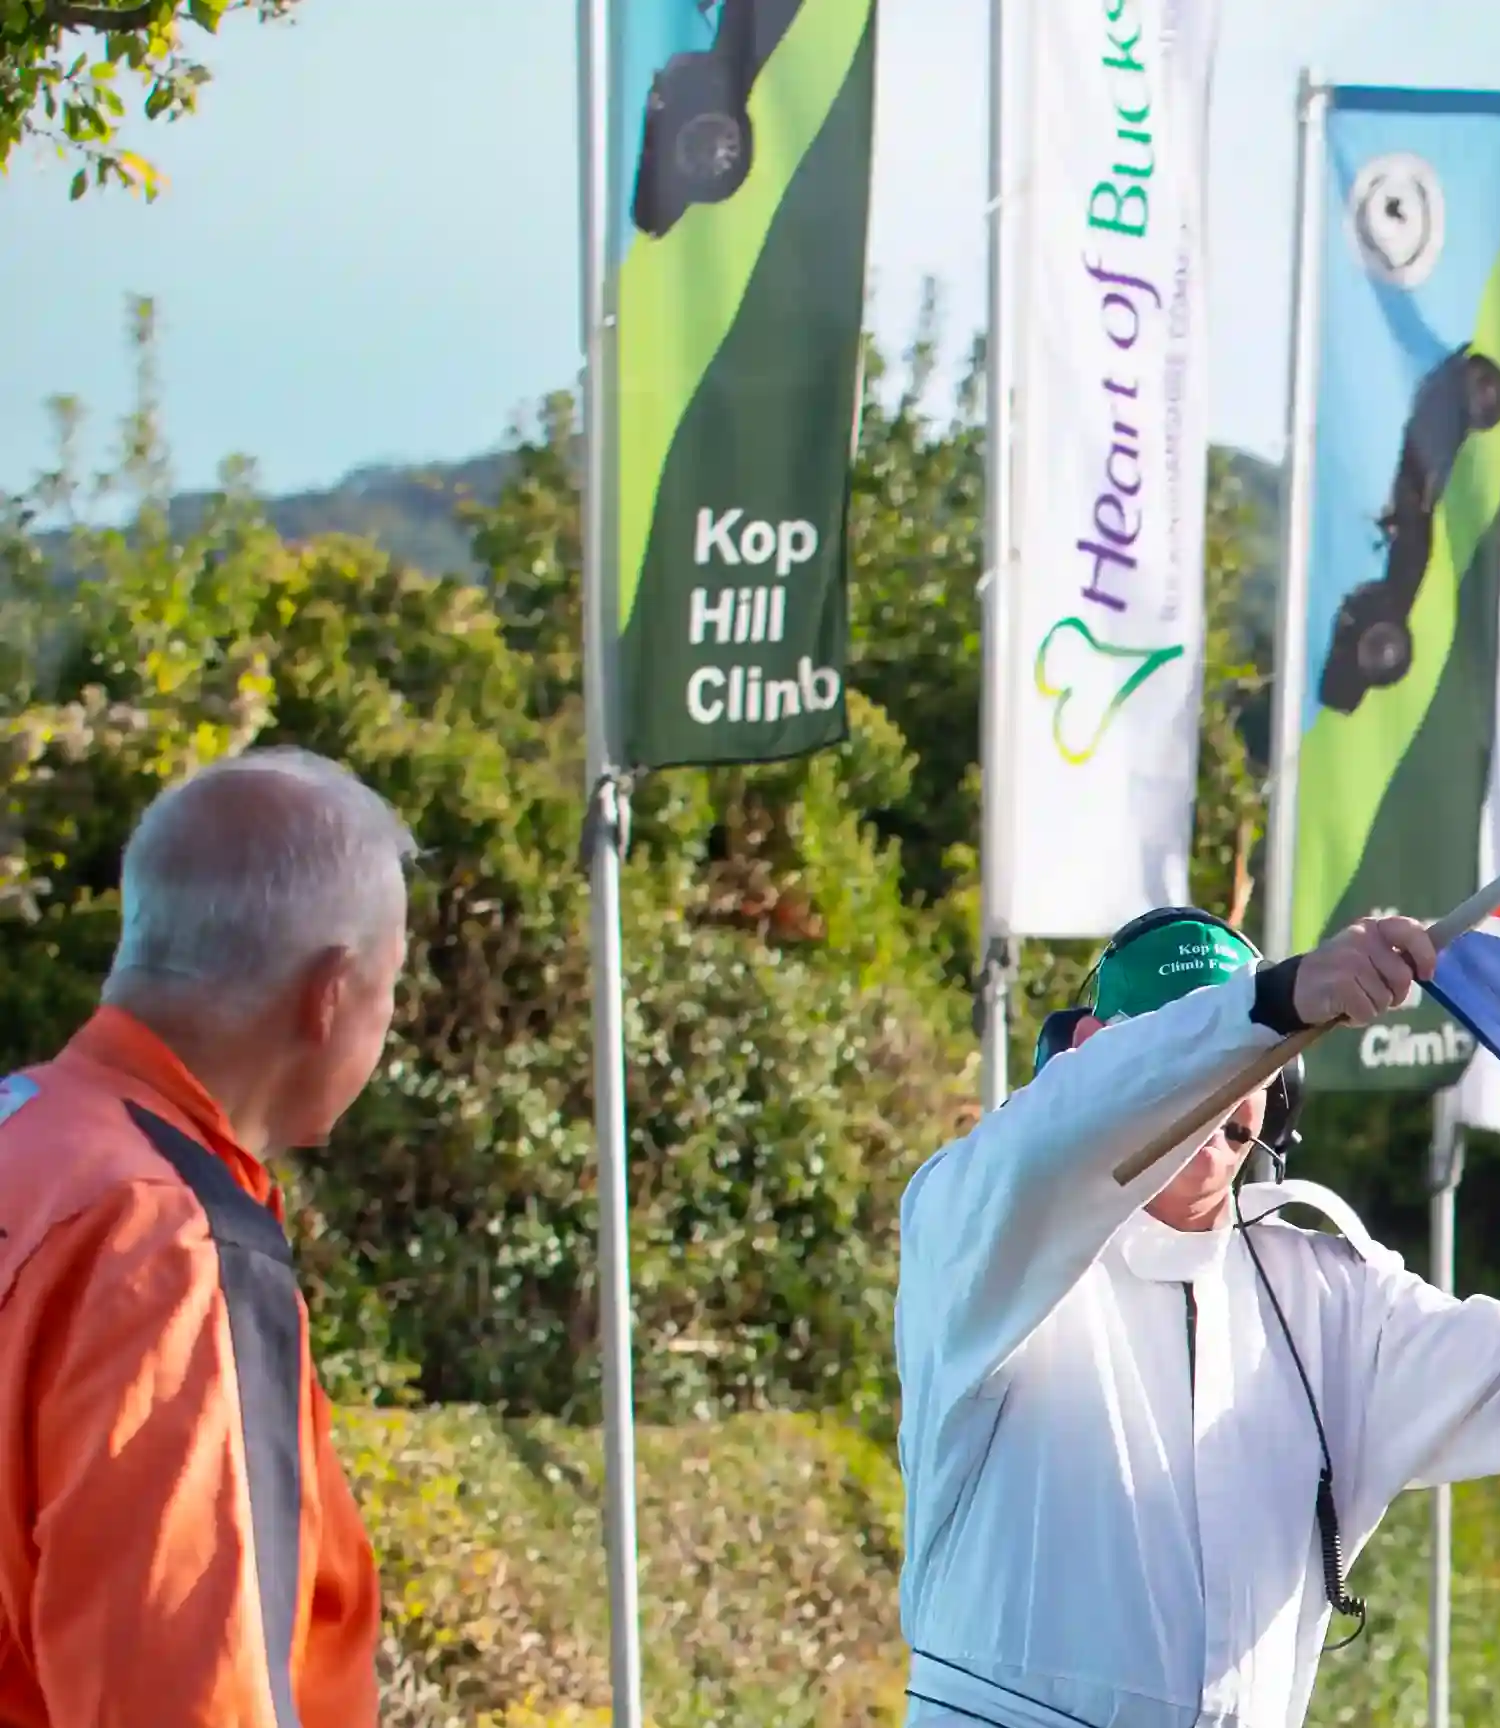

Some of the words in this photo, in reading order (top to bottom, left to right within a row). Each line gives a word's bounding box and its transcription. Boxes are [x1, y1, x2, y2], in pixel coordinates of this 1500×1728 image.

[1083, 250, 1162, 349] of
[1077, 377, 1142, 613] Heart
[695, 506, 819, 577] Kop
[689, 584, 786, 645] Hill
[1158, 959, 1205, 976] Climb
[1178, 943, 1210, 956] Kop
[1360, 1020, 1476, 1069] Climb
